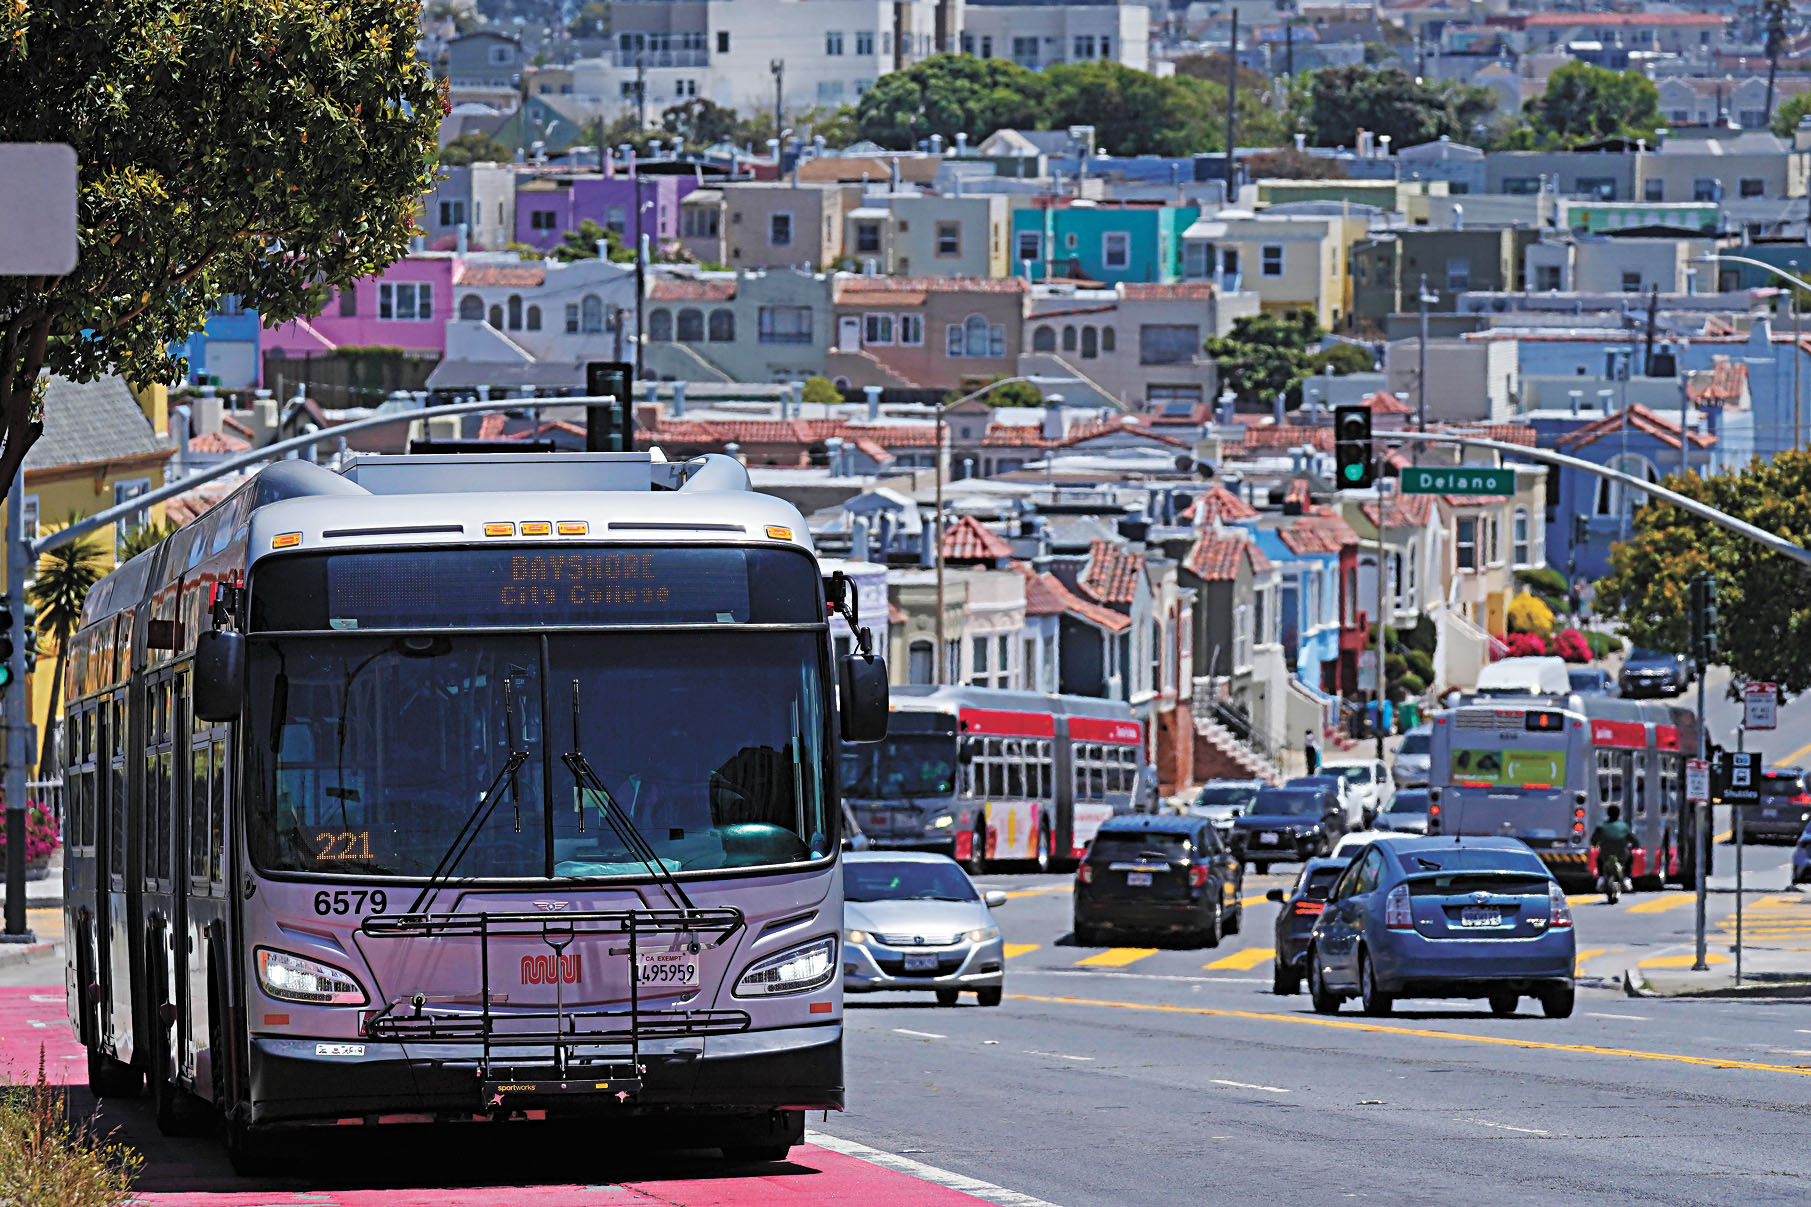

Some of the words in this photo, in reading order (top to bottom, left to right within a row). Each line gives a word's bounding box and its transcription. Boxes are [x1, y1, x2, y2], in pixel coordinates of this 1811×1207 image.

[1420, 473, 1497, 489] Delano
[512, 554, 656, 580] BAYSHORE
[501, 586, 556, 604] City
[571, 585, 670, 603] College
[316, 831, 374, 860] 221
[314, 889, 387, 916] 6579
[497, 1083, 536, 1092] sportworks
